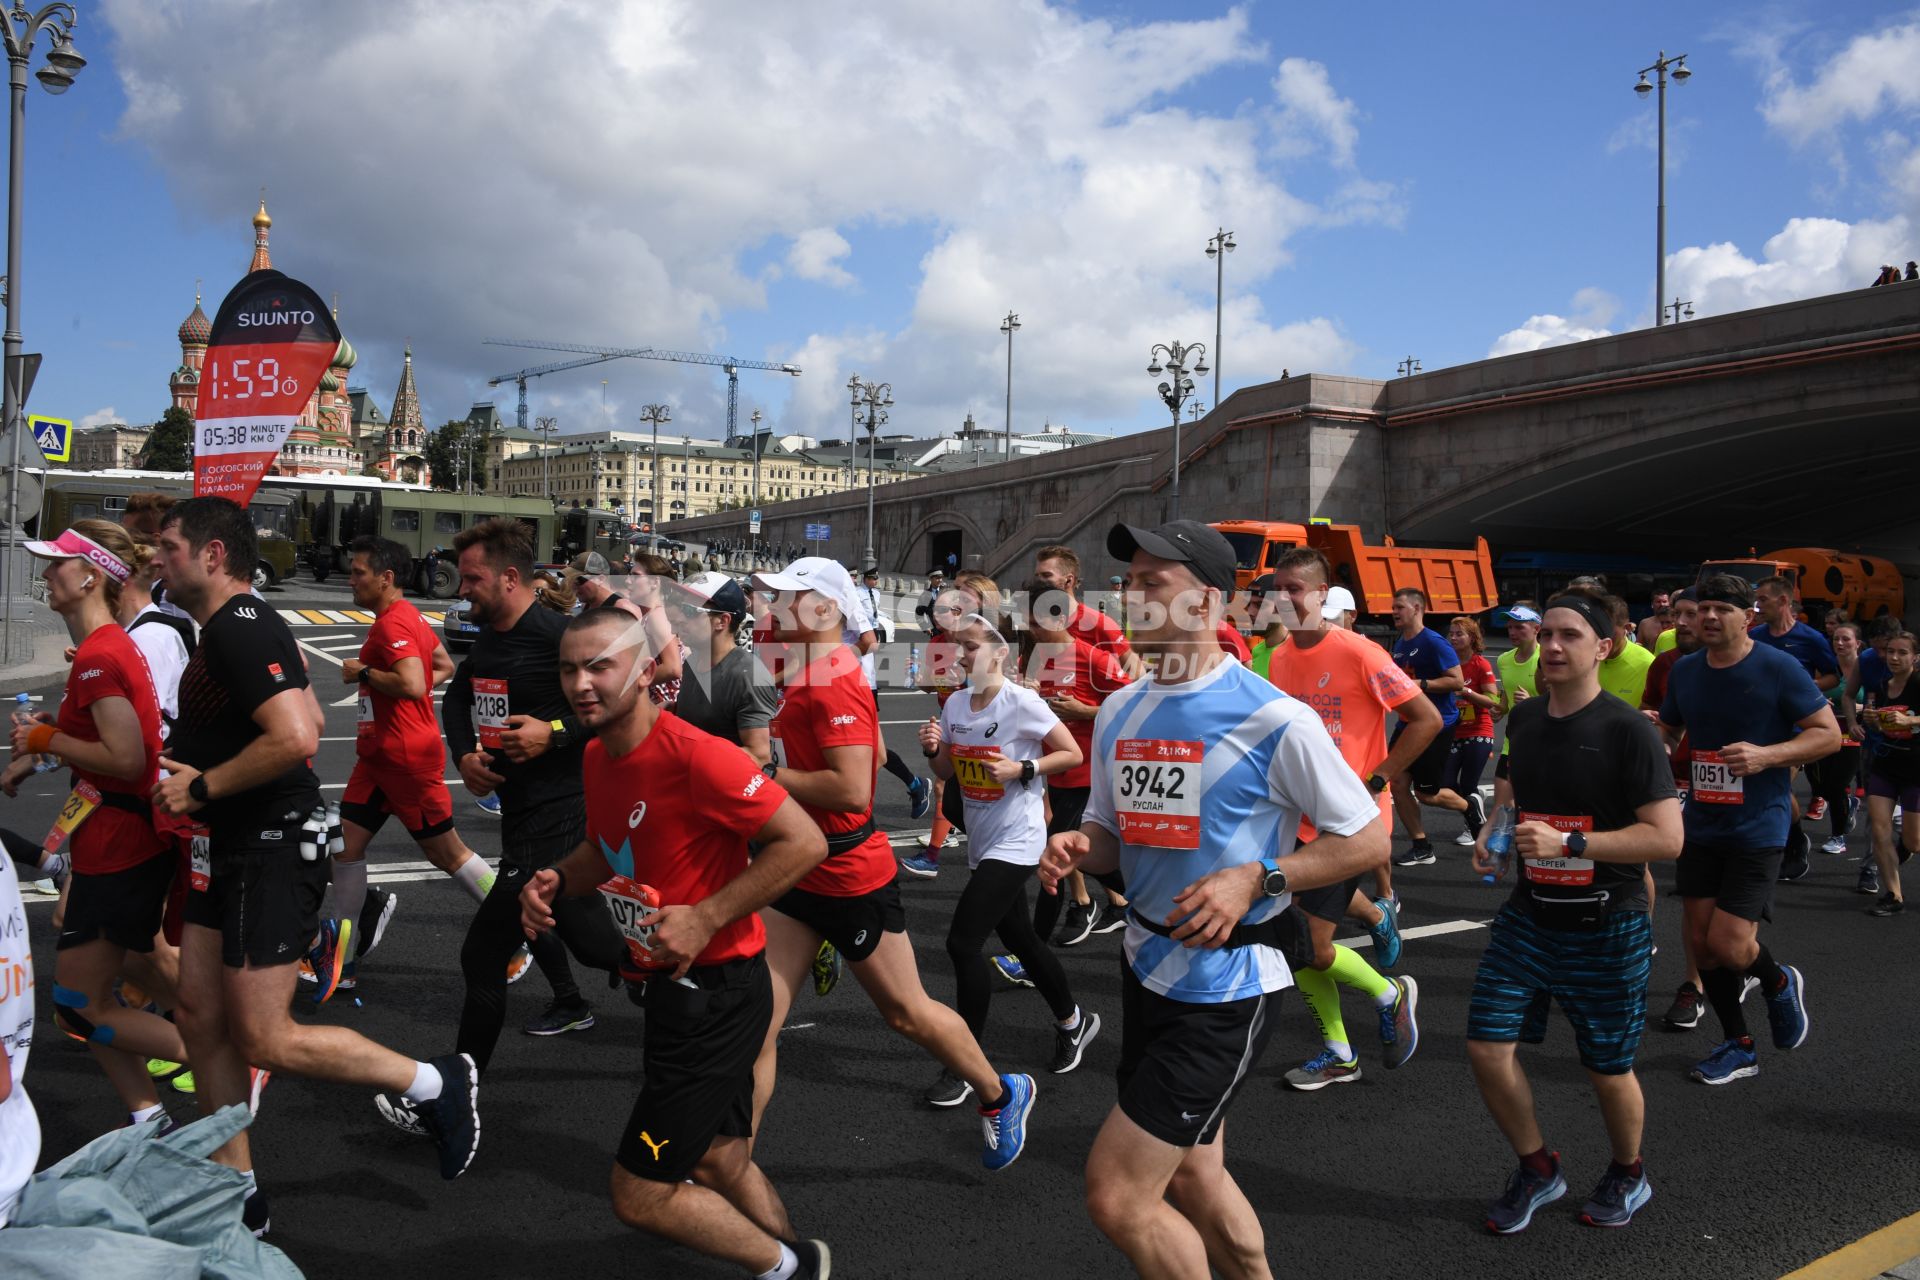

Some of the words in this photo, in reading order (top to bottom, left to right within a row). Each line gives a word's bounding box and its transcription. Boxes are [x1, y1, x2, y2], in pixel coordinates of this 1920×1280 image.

[238, 311, 315, 327] SUUNTO
[212, 358, 279, 399] 1:59
[250, 424, 286, 434] MINUTE
[204, 426, 247, 446] 05:38
[250, 435, 264, 443] KM
[752, 511, 759, 521] P
[477, 695, 507, 718] 2138
[1157, 745, 1174, 757] 21,1
[1174, 747, 1191, 757] KM
[1120, 765, 1185, 799] 3942
[1132, 800, 1164, 811] РУСЛАН
[1537, 860, 1566, 868] СЕРГЕЙ
